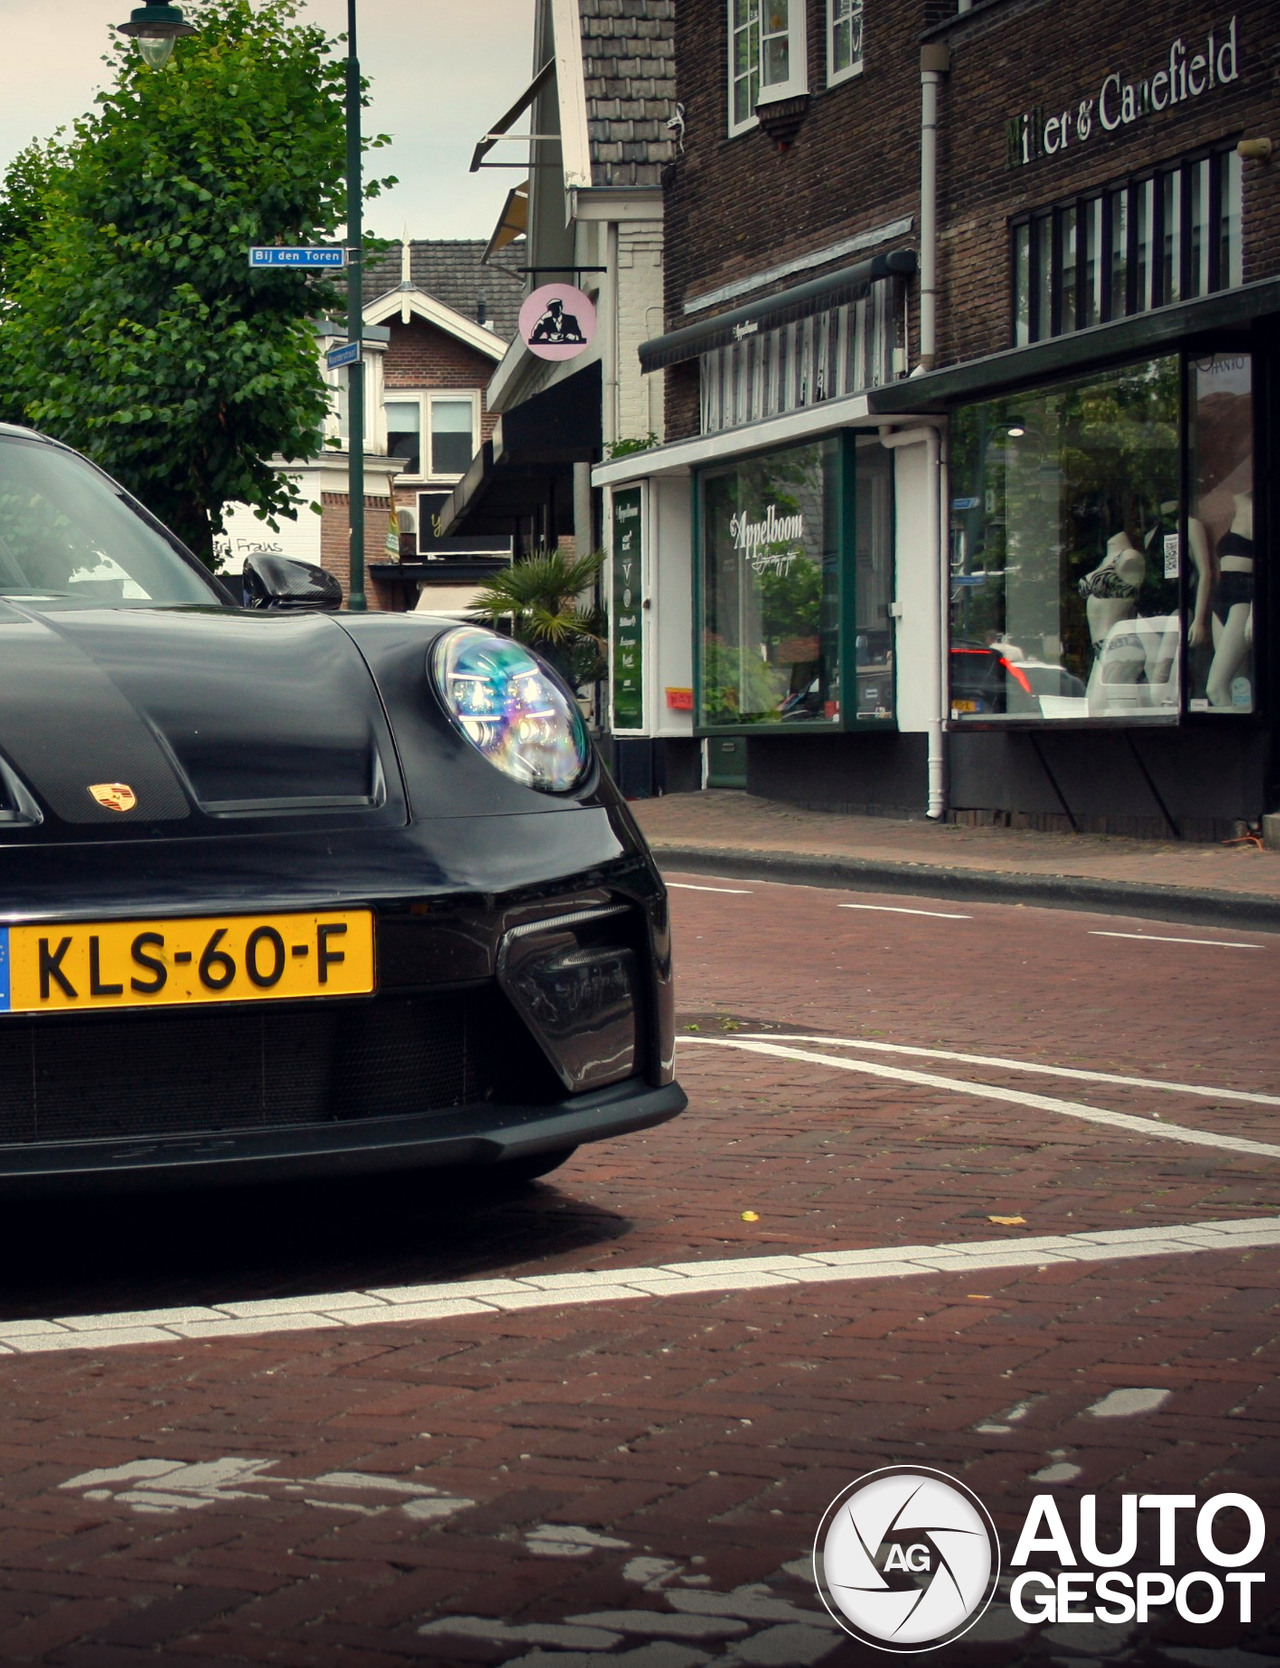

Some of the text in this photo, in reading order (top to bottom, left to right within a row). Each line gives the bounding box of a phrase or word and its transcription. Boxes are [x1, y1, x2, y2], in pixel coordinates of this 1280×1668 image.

[1077, 99, 1093, 141] &
[255, 250, 339, 263] Bij den Toren
[730, 504, 803, 560] Appelboom
[37, 923, 347, 1001] KLS-60-F
